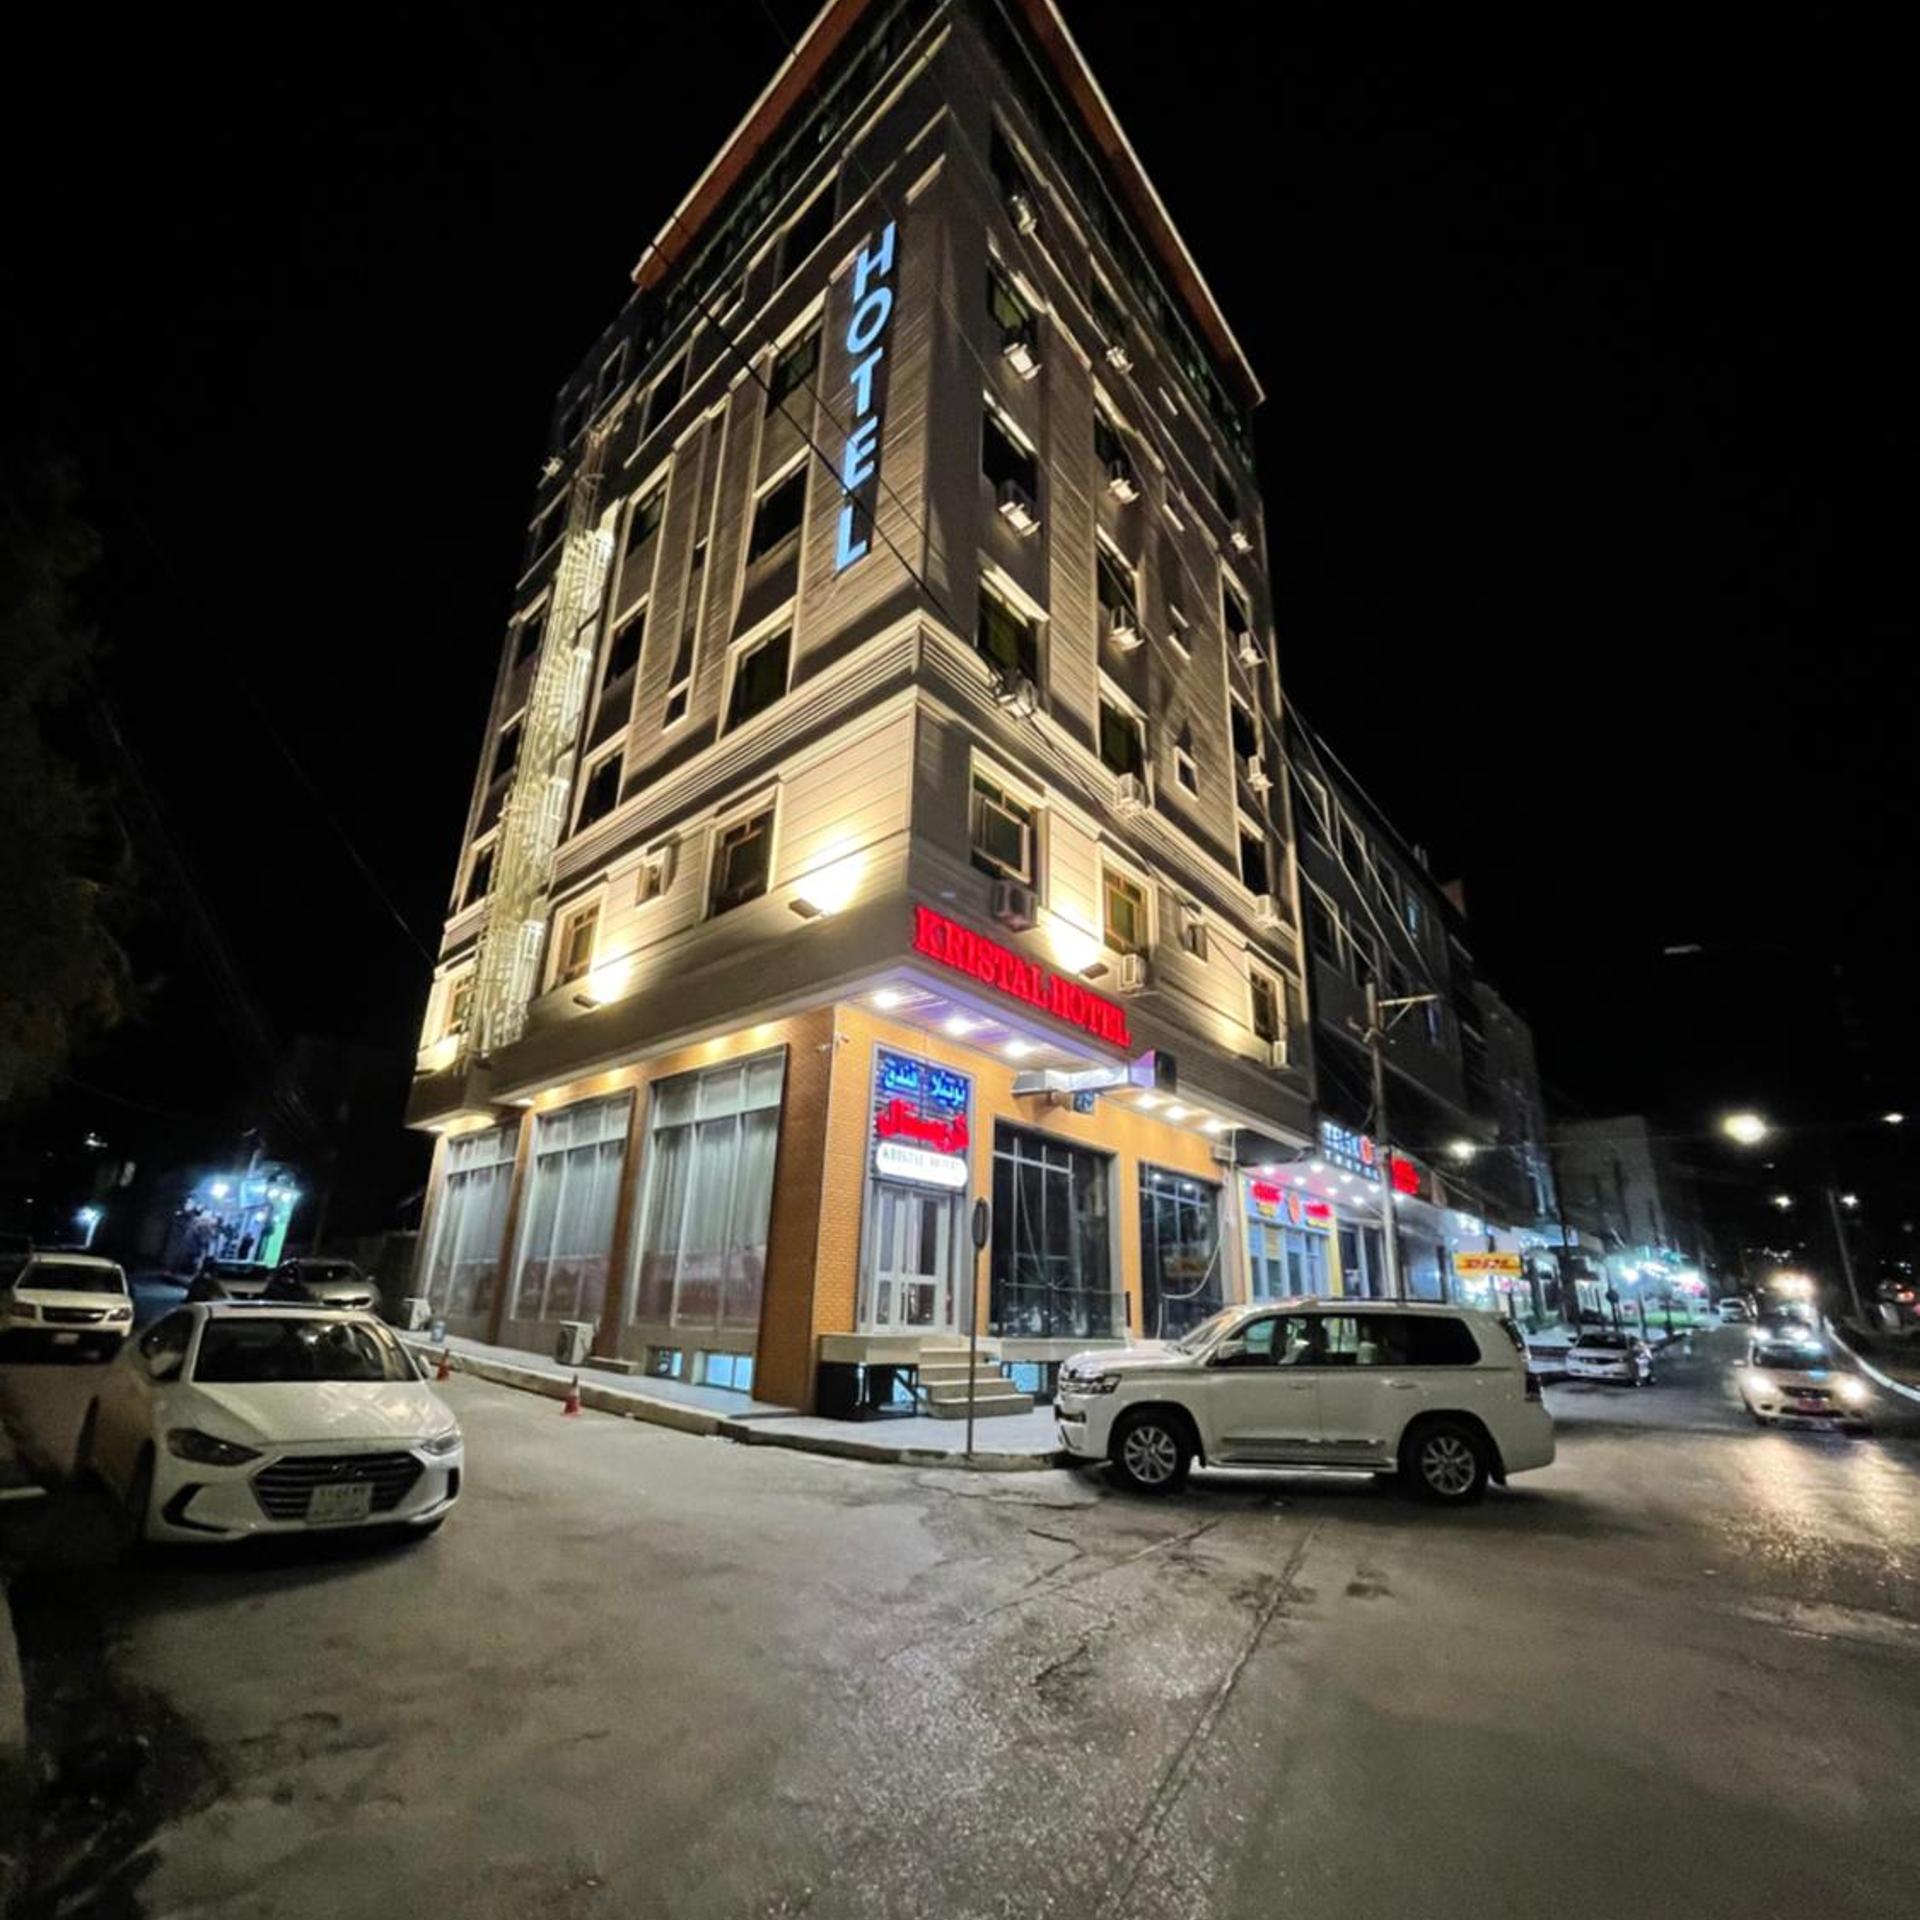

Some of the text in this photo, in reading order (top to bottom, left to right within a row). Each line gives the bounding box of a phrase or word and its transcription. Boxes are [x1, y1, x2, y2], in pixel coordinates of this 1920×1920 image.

[834, 221, 896, 572] HOTEL
[914, 902, 1132, 1048] KRISTAL HOTEL
